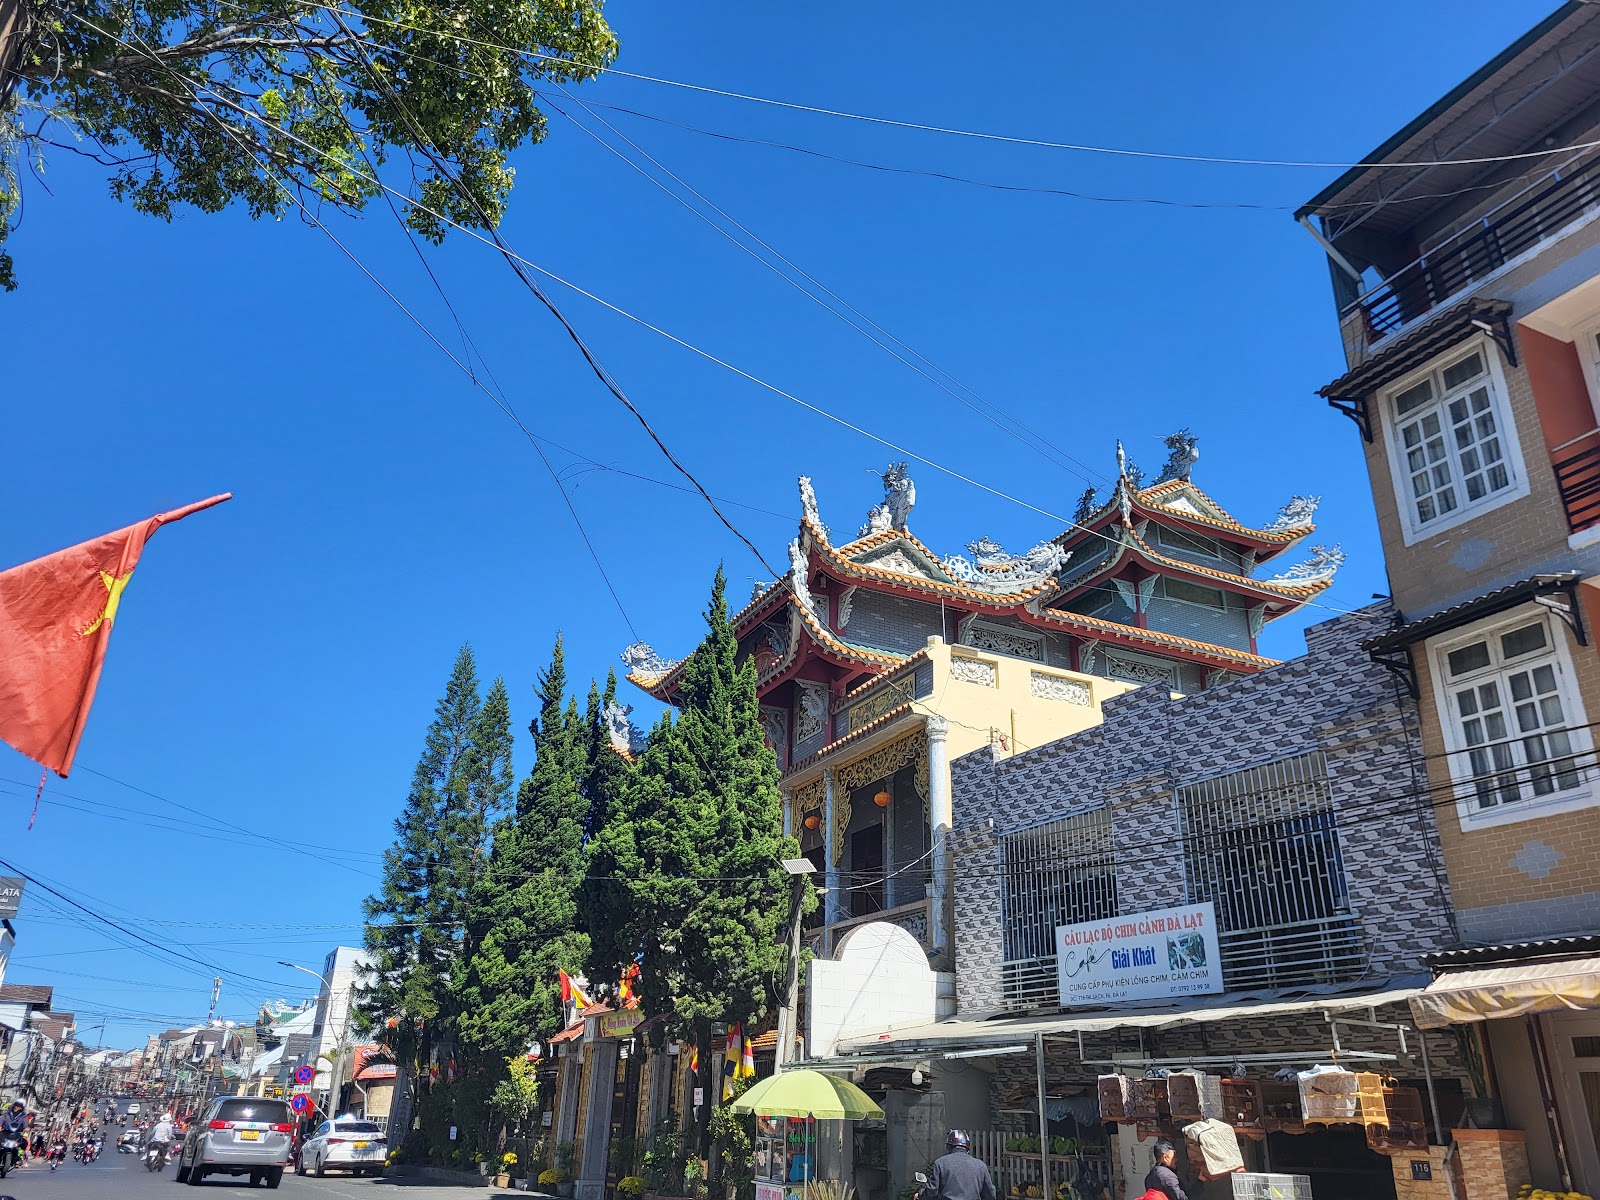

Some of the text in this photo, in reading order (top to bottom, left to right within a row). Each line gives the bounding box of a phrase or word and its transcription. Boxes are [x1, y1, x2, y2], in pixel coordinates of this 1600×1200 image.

[1064, 912, 1203, 946] CÂU LẠC BỘ CHIM CẢNH ĐÀ LẠT
[1065, 945, 1156, 978] Café Giải Khát
[1069, 982, 1087, 991] CUNG
[1087, 979, 1101, 990] CẤP
[1101, 979, 1114, 989] PHỤ
[1189, 969, 1209, 980] CHIM
[1414, 1163, 1429, 1172] 116
